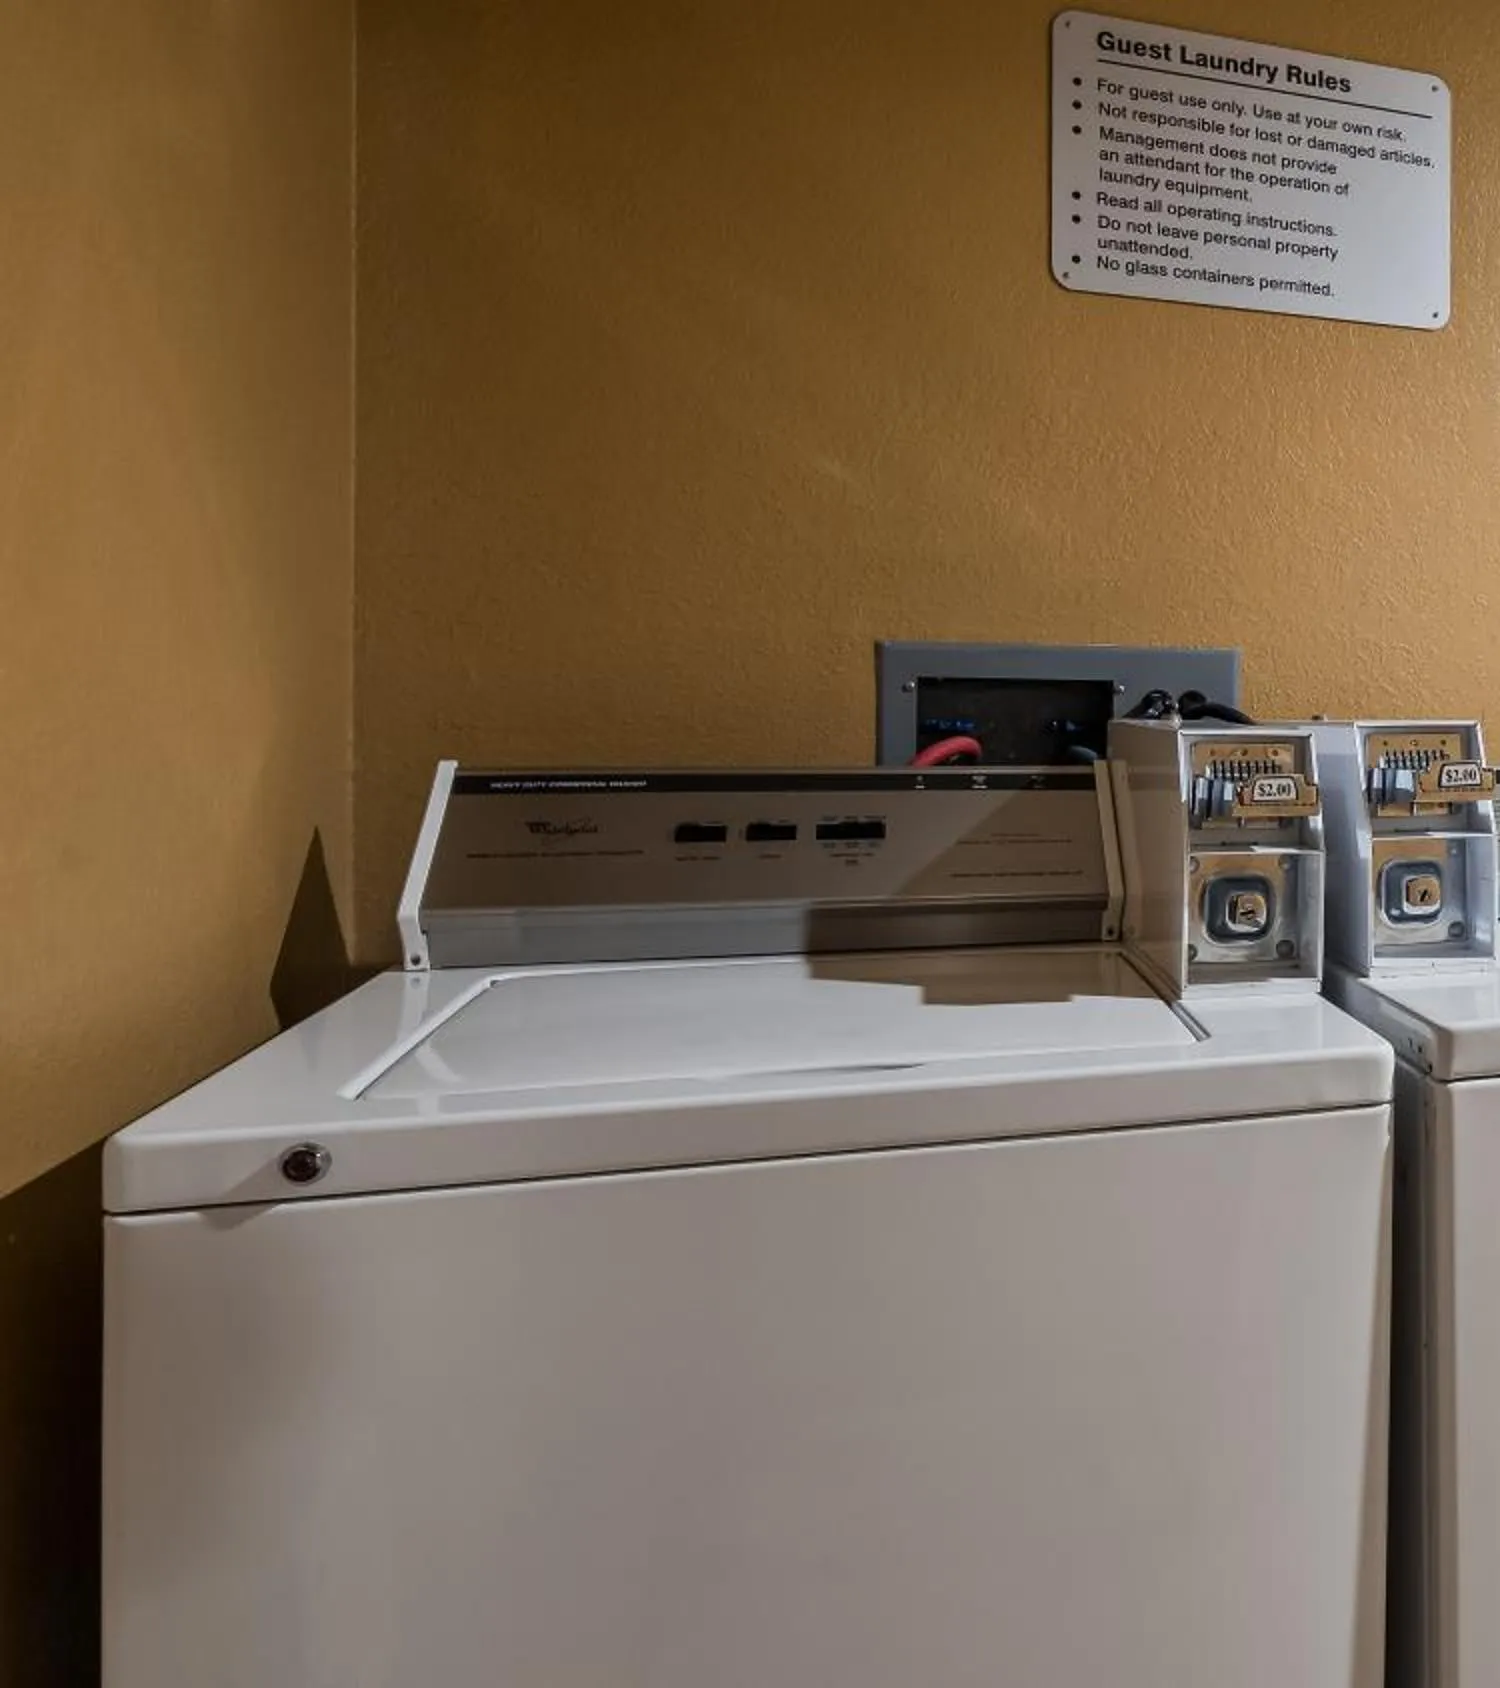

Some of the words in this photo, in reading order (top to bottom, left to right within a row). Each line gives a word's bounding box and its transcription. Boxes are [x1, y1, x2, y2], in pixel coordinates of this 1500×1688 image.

[1097, 32, 1172, 61] Guest
[1180, 46, 1278, 83] Laundry
[1286, 64, 1351, 92] Rules
[1097, 78, 1123, 95] For
[1129, 86, 1174, 103] guest
[1179, 95, 1207, 109] use
[1212, 99, 1246, 118] only.
[1253, 103, 1282, 120] Use
[1286, 111, 1300, 125] at
[1306, 115, 1338, 130] your
[1342, 122, 1373, 136] own
[1377, 127, 1406, 143] risk.
[1098, 102, 1127, 119] Not
[1132, 110, 1225, 134] responsible
[1230, 122, 1250, 138] for
[1256, 127, 1282, 144] lost
[1287, 135, 1302, 146] or
[1307, 136, 1375, 159] damaged
[1380, 149, 1435, 168] articles.
[1099, 126, 1204, 154] Management
[1210, 144, 1247, 161] does
[1252, 152, 1276, 165] not
[1281, 157, 1337, 175] provide
[1099, 150, 1119, 163] an
[1124, 152, 1200, 174] attendant
[1204, 162, 1226, 178] for
[1230, 167, 1254, 182] the
[1259, 173, 1330, 194] operation
[1334, 182, 1349, 196] of
[1099, 168, 1160, 192] laundry
[1165, 179, 1252, 202] equipment.
[1097, 192, 1139, 210] Read
[1143, 200, 1162, 213] all
[1167, 204, 1241, 227] operating
[1246, 212, 1338, 236] instructions.
[1097, 215, 1120, 231] Do
[1126, 221, 1152, 235] not
[1157, 222, 1199, 241] leave
[1203, 231, 1270, 250] personal
[1275, 241, 1339, 262] property
[1097, 237, 1193, 260] unattended.
[1097, 256, 1120, 271] No
[1125, 259, 1168, 277] glass
[1172, 266, 1255, 286] containers
[1259, 277, 1335, 297] permitted.
[1257, 783, 1292, 797] $2.00
